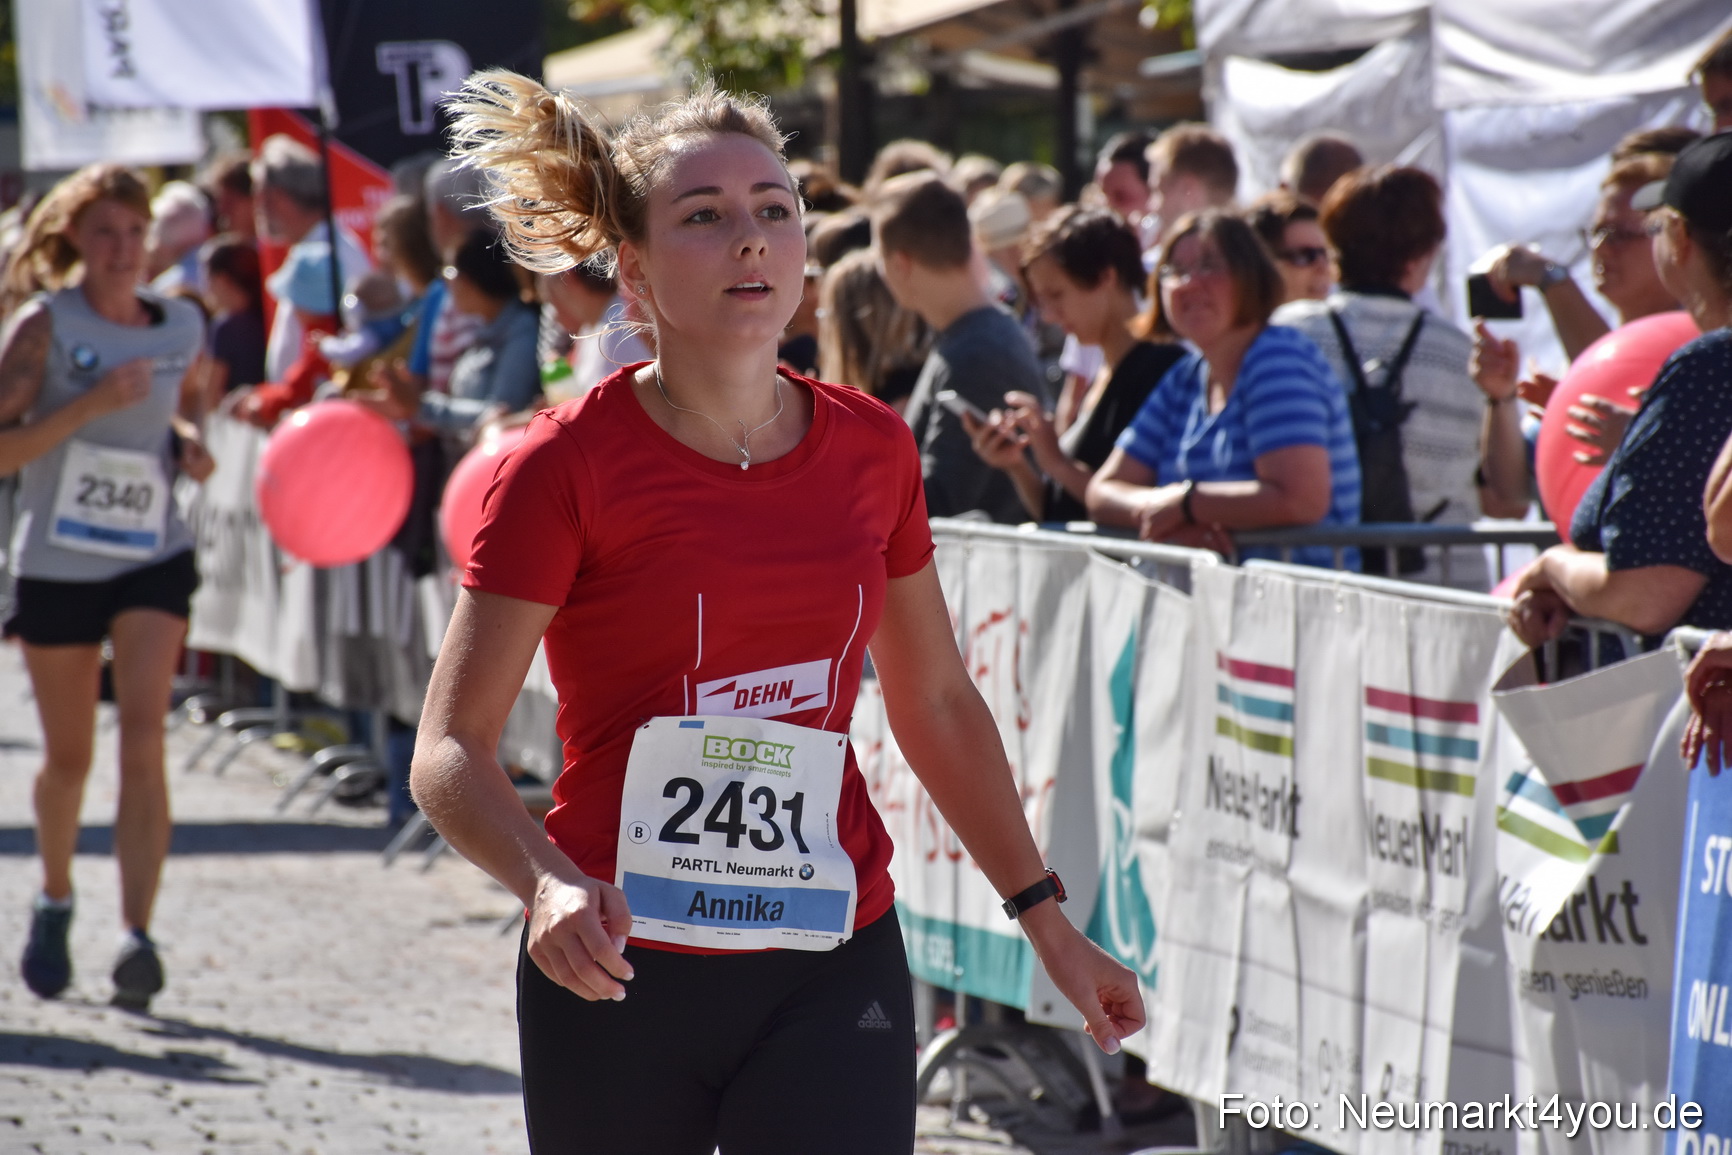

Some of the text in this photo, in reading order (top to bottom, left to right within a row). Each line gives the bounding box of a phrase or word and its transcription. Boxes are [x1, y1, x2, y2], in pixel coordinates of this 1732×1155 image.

[76, 473, 154, 514] 2340
[733, 679, 794, 710] DEHN
[703, 735, 795, 769] BOCK
[701, 759, 792, 778] inspired by smart concepts
[658, 776, 811, 854] 2431
[671, 856, 795, 878] PARTL Neumarkt
[687, 890, 785, 922] Annika
[858, 1018, 892, 1029] adidas
